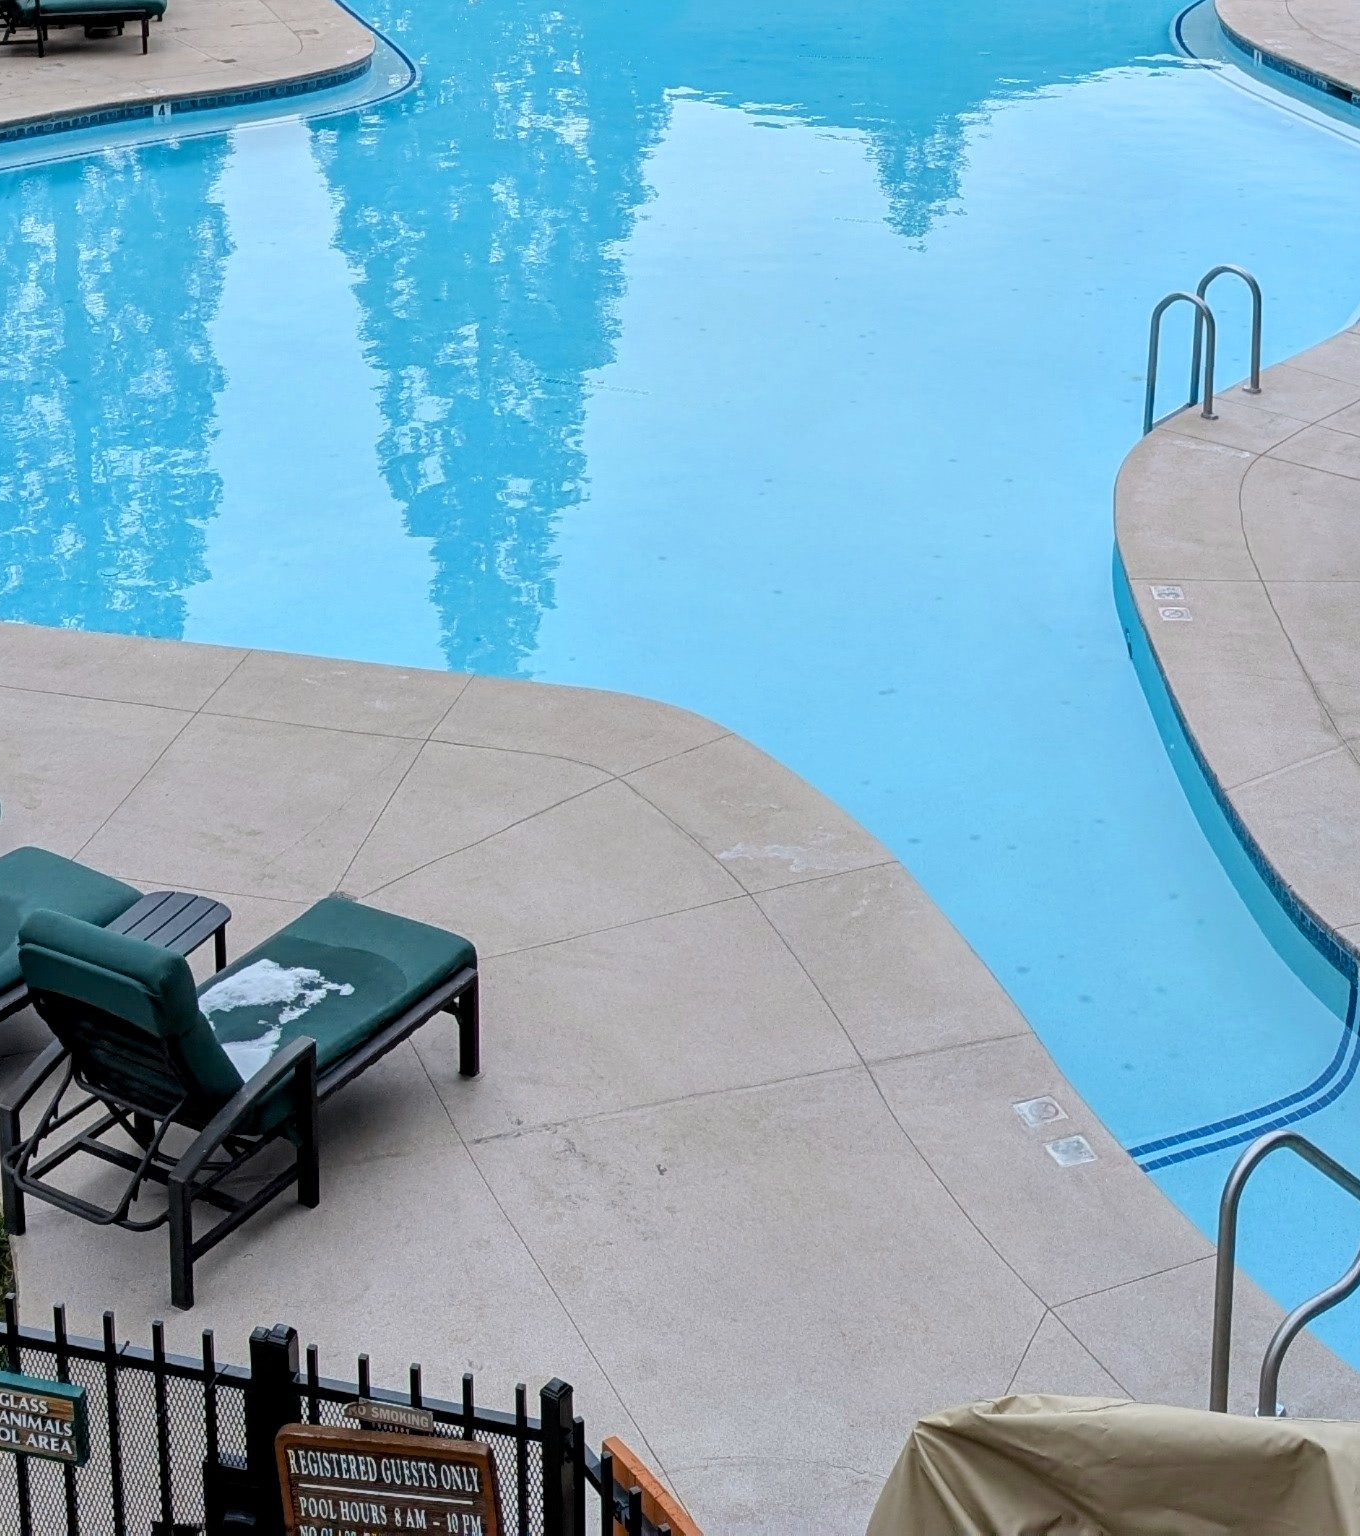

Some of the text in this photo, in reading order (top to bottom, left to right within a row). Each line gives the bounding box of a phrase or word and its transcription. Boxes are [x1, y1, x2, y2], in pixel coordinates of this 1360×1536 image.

[348, 1405, 429, 1428] NO SMOKING
[26, 1433, 73, 1455] AREA
[287, 1449, 480, 1493] REGISTERED GUESTS ONLY
[299, 1496, 337, 1520] POOL
[339, 1500, 387, 1525] HOURS
[394, 1507, 402, 1527] 8
[406, 1508, 427, 1530] AM
[446, 1512, 459, 1534] 10
[462, 1514, 482, 1536] PM
